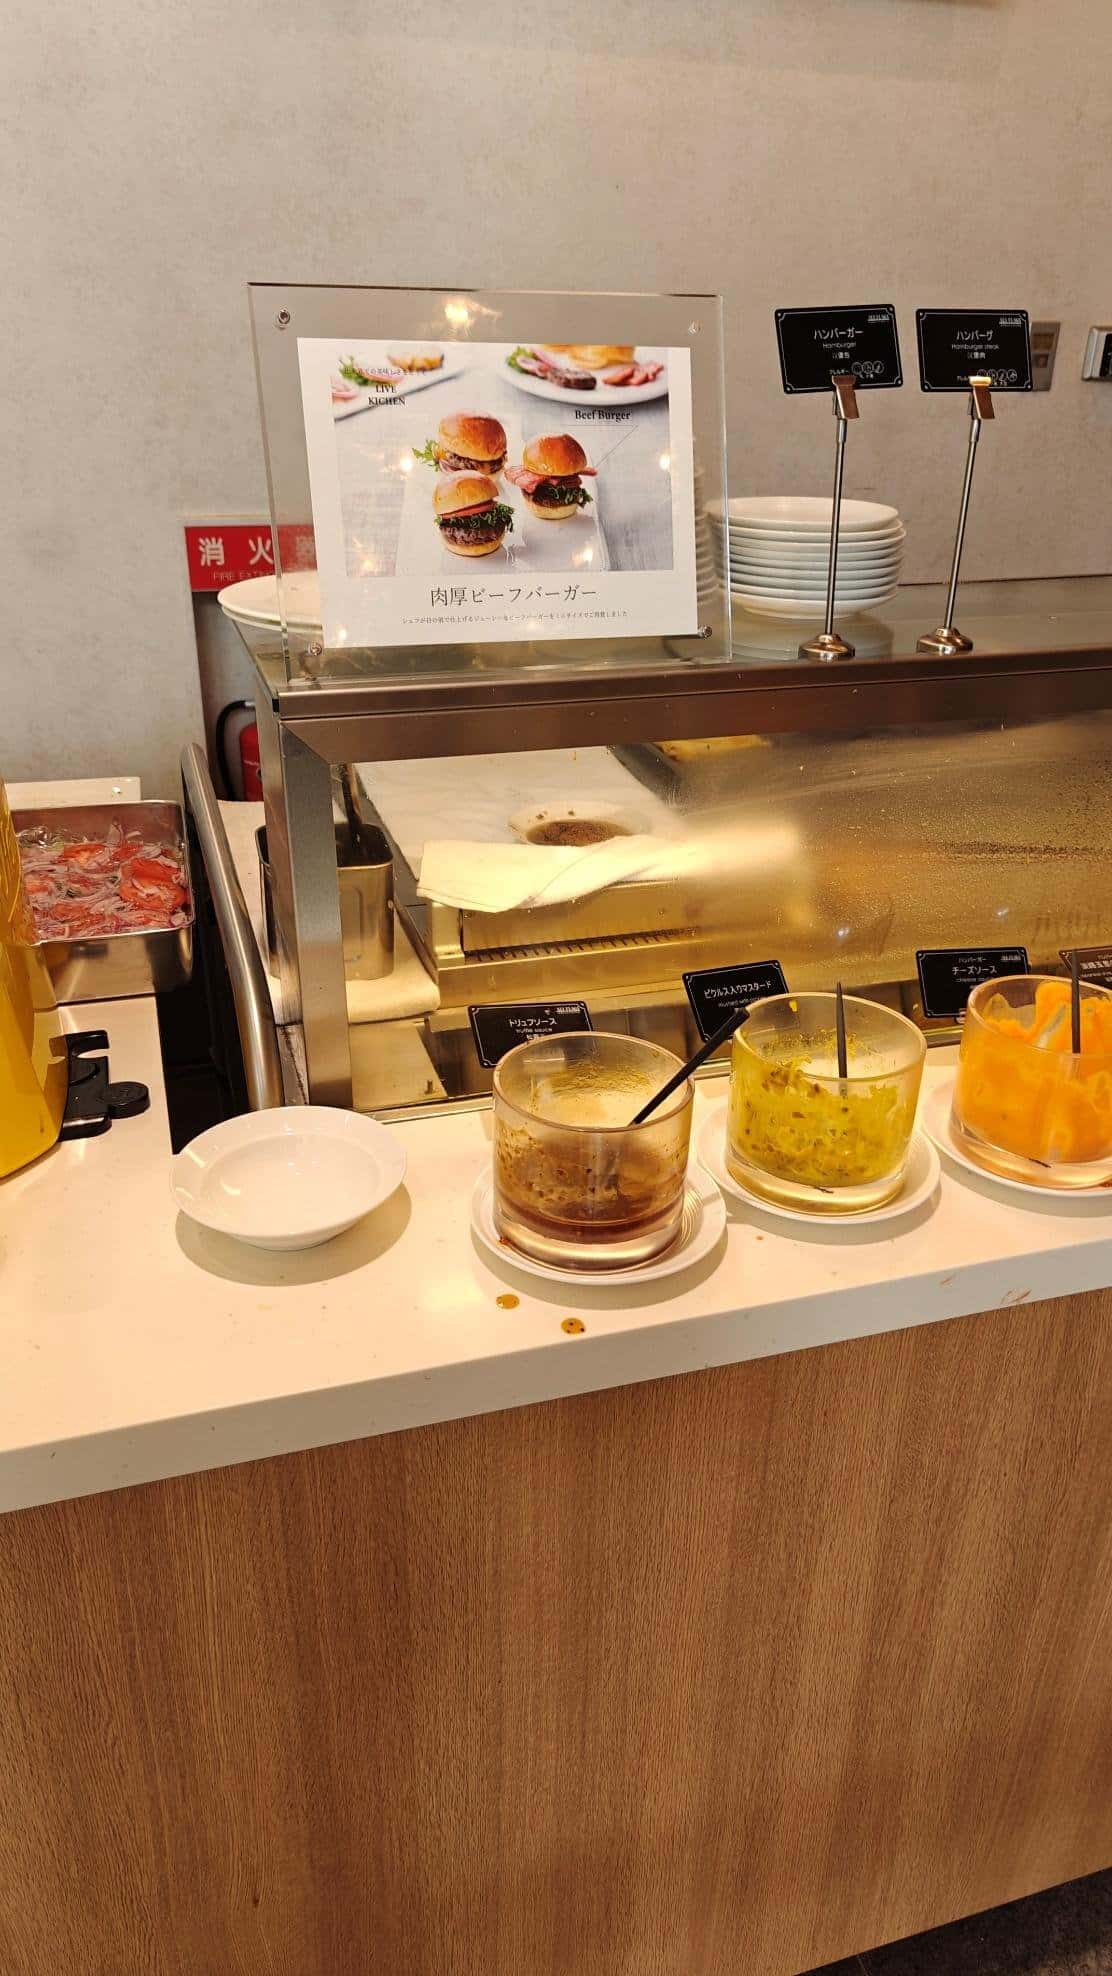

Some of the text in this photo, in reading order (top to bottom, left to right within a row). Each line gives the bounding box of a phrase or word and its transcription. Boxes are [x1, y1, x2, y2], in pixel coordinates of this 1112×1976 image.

[813, 327, 864, 340] ハンバーガー
[956, 330, 993, 341] ハンバーグ
[376, 384, 397, 394] LIVE
[575, 410, 631, 423] Beef Burger
[431, 585, 597, 607] 肉厚ビーフバーガー
[952, 965, 998, 975] チーズソース
[509, 1017, 557, 1027] トリュフソース
